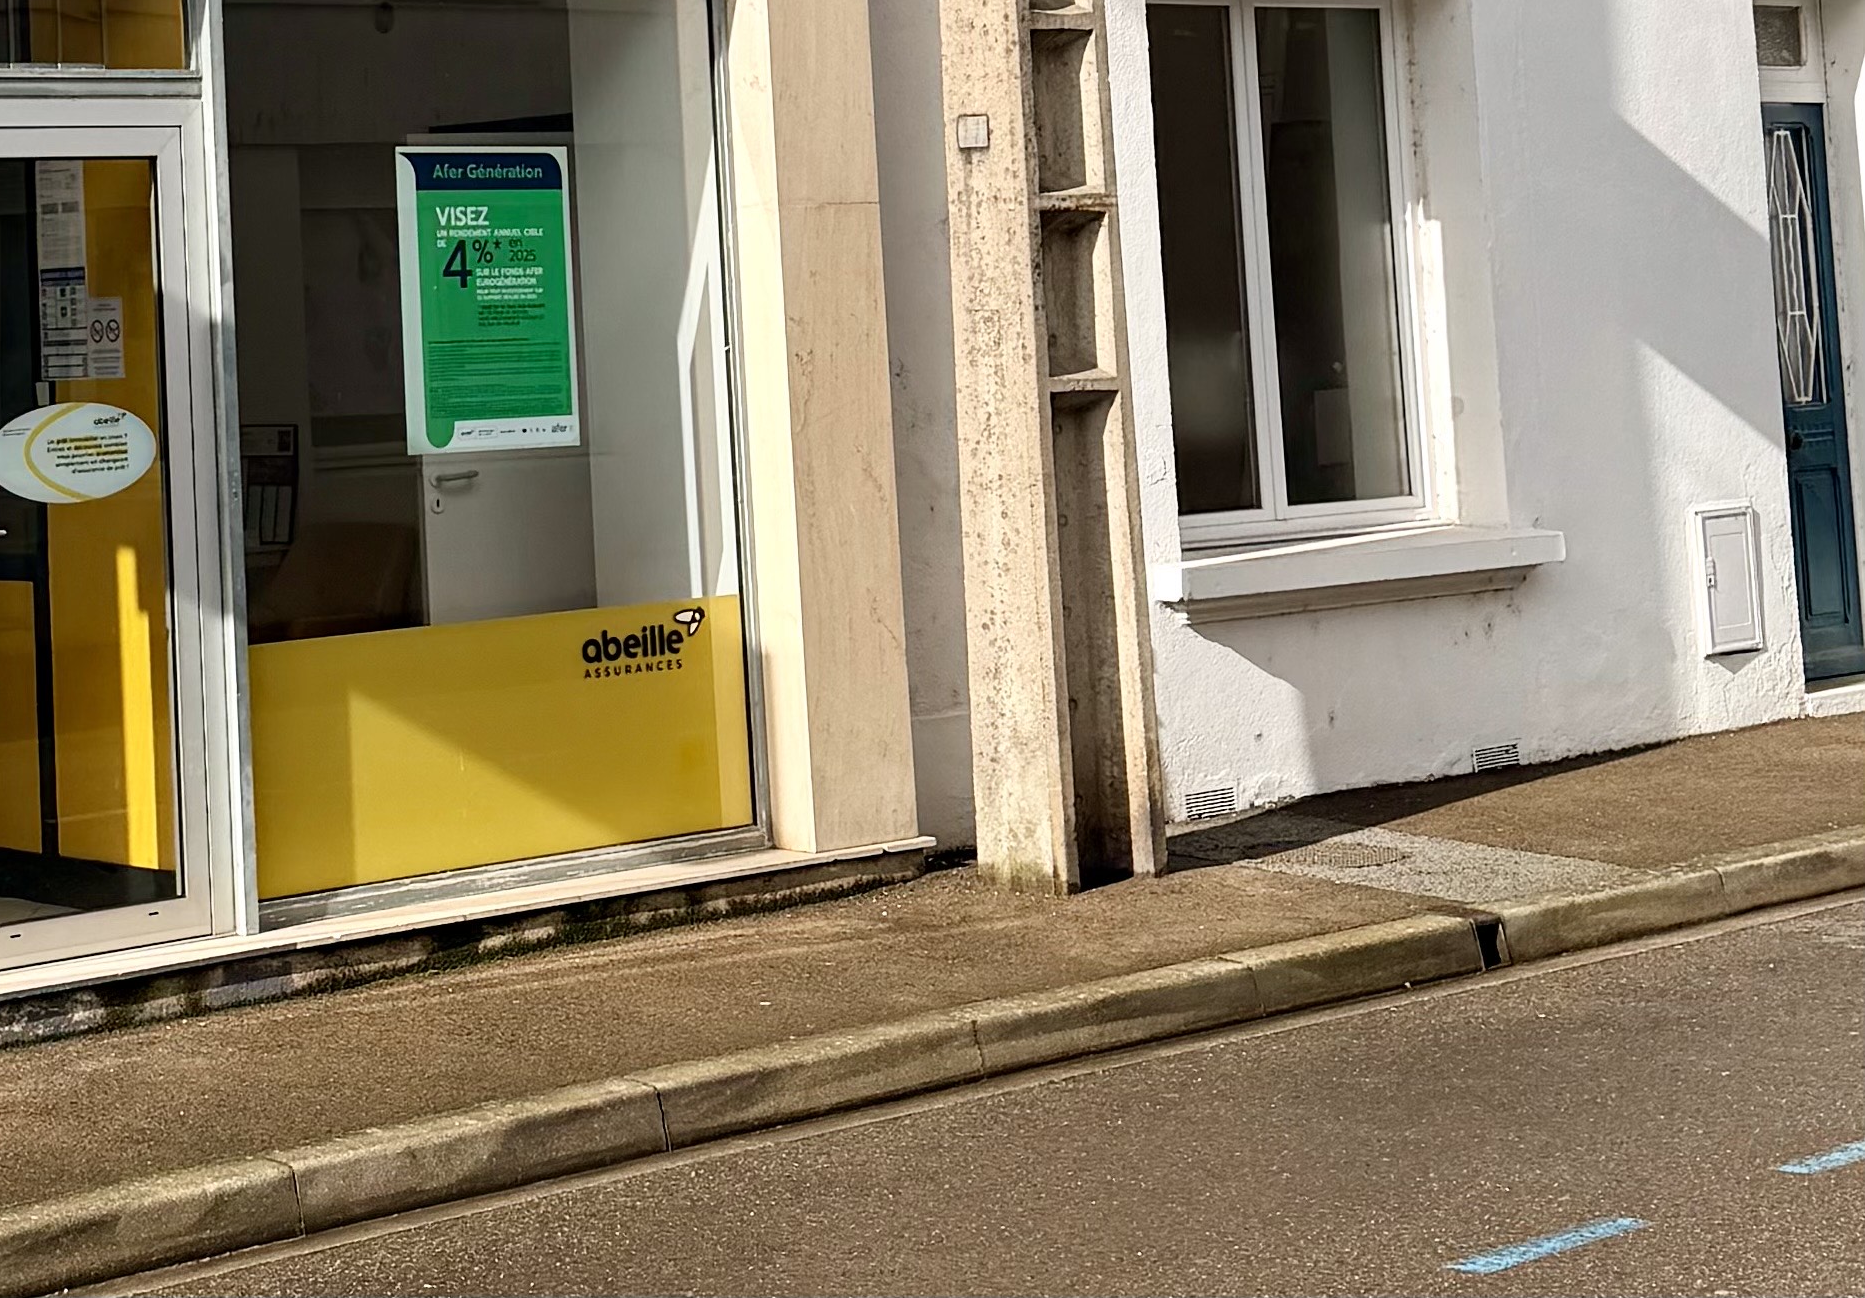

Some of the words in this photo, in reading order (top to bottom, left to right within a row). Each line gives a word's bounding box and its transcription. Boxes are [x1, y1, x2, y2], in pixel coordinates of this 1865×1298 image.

[433, 163, 464, 178] Afer
[467, 163, 543, 178] Génération
[436, 206, 489, 226] VISEZ
[509, 239, 523, 248] en
[509, 250, 536, 262] 2025
[582, 624, 684, 664] abeille
[584, 659, 683, 679] ASSURANCES
